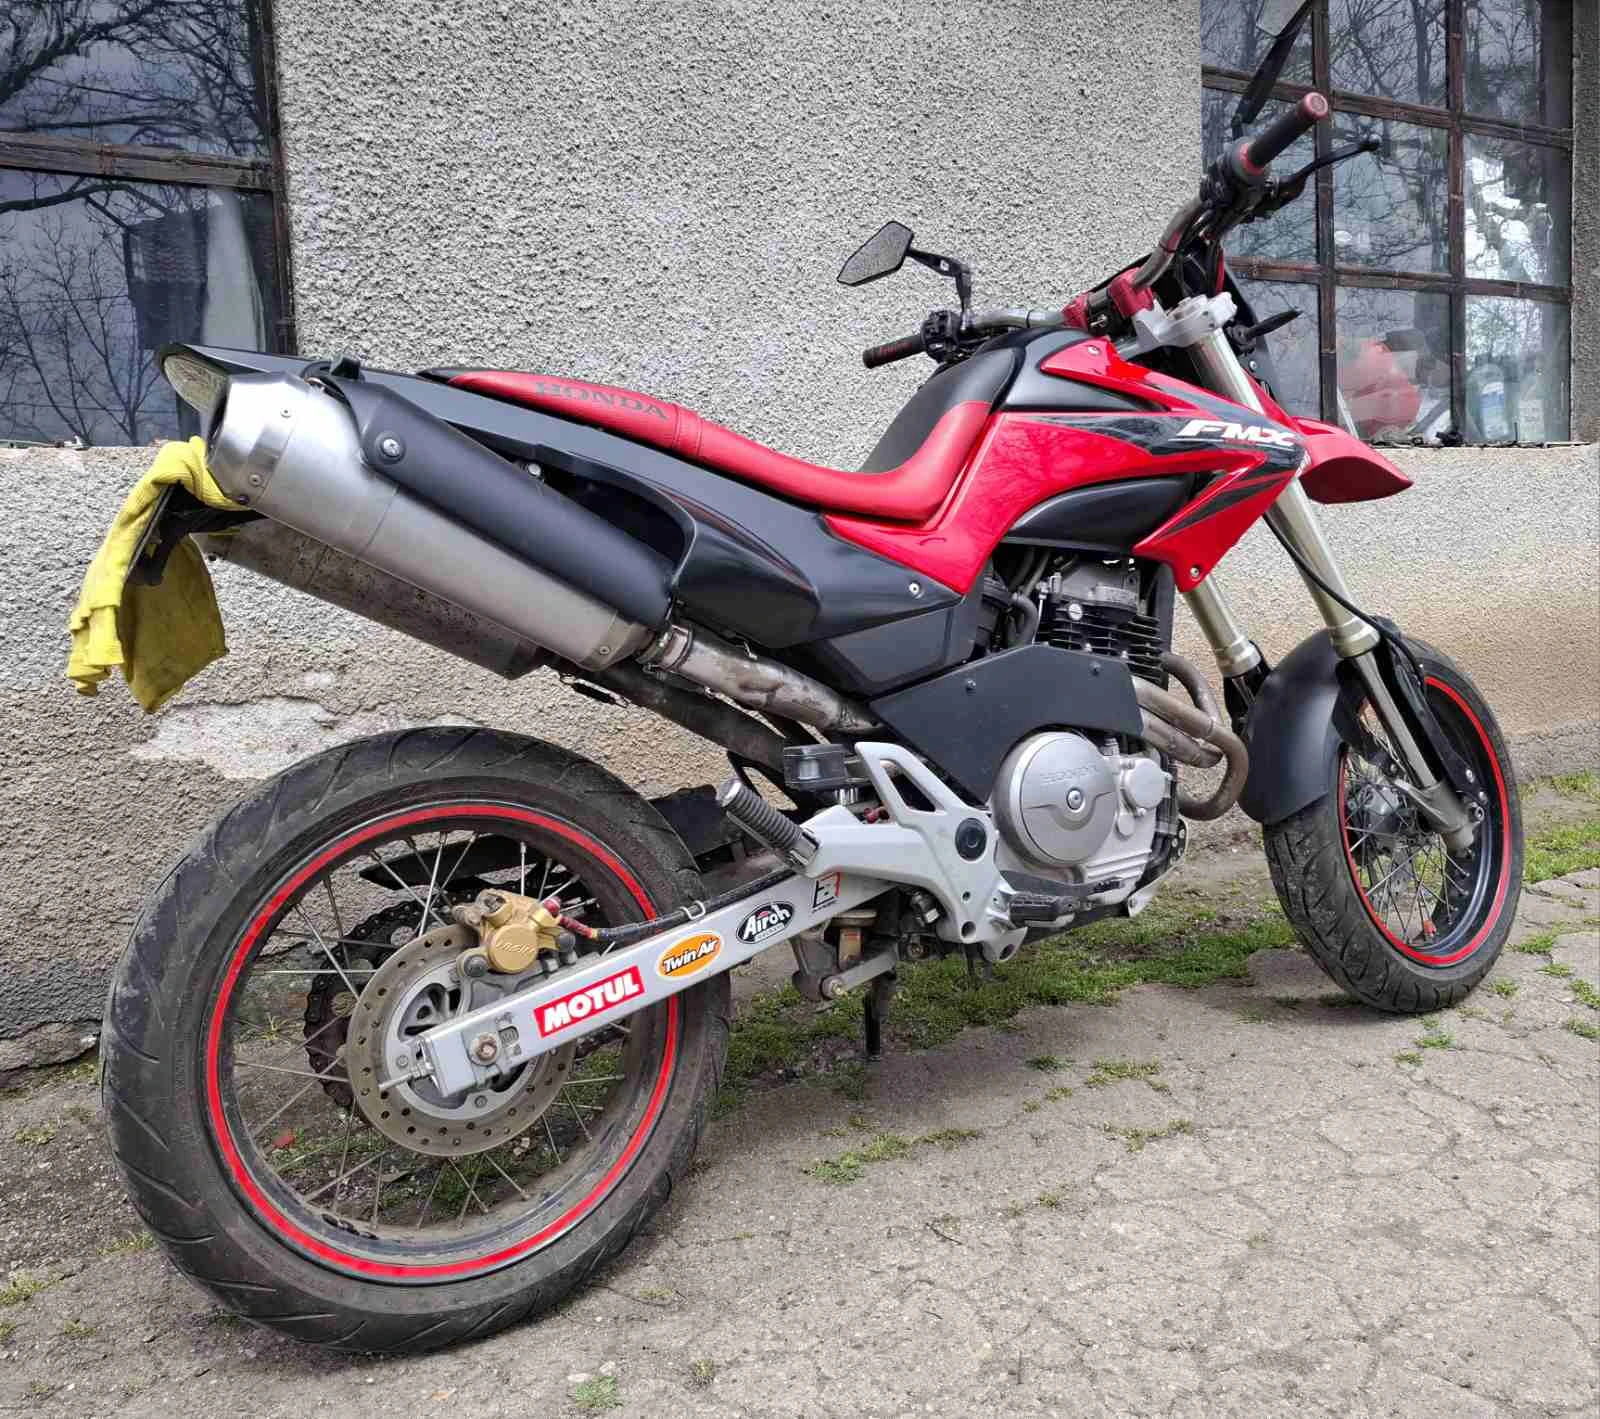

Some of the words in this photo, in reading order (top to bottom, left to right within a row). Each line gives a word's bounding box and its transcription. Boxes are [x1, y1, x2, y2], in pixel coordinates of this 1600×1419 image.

[534, 382, 668, 421] HONDA
[1176, 419, 1297, 447] FMX
[743, 904, 790, 939] Airoh
[663, 948, 697, 975] Twin
[696, 937, 719, 959] Air
[543, 972, 640, 1033] MOTUL
